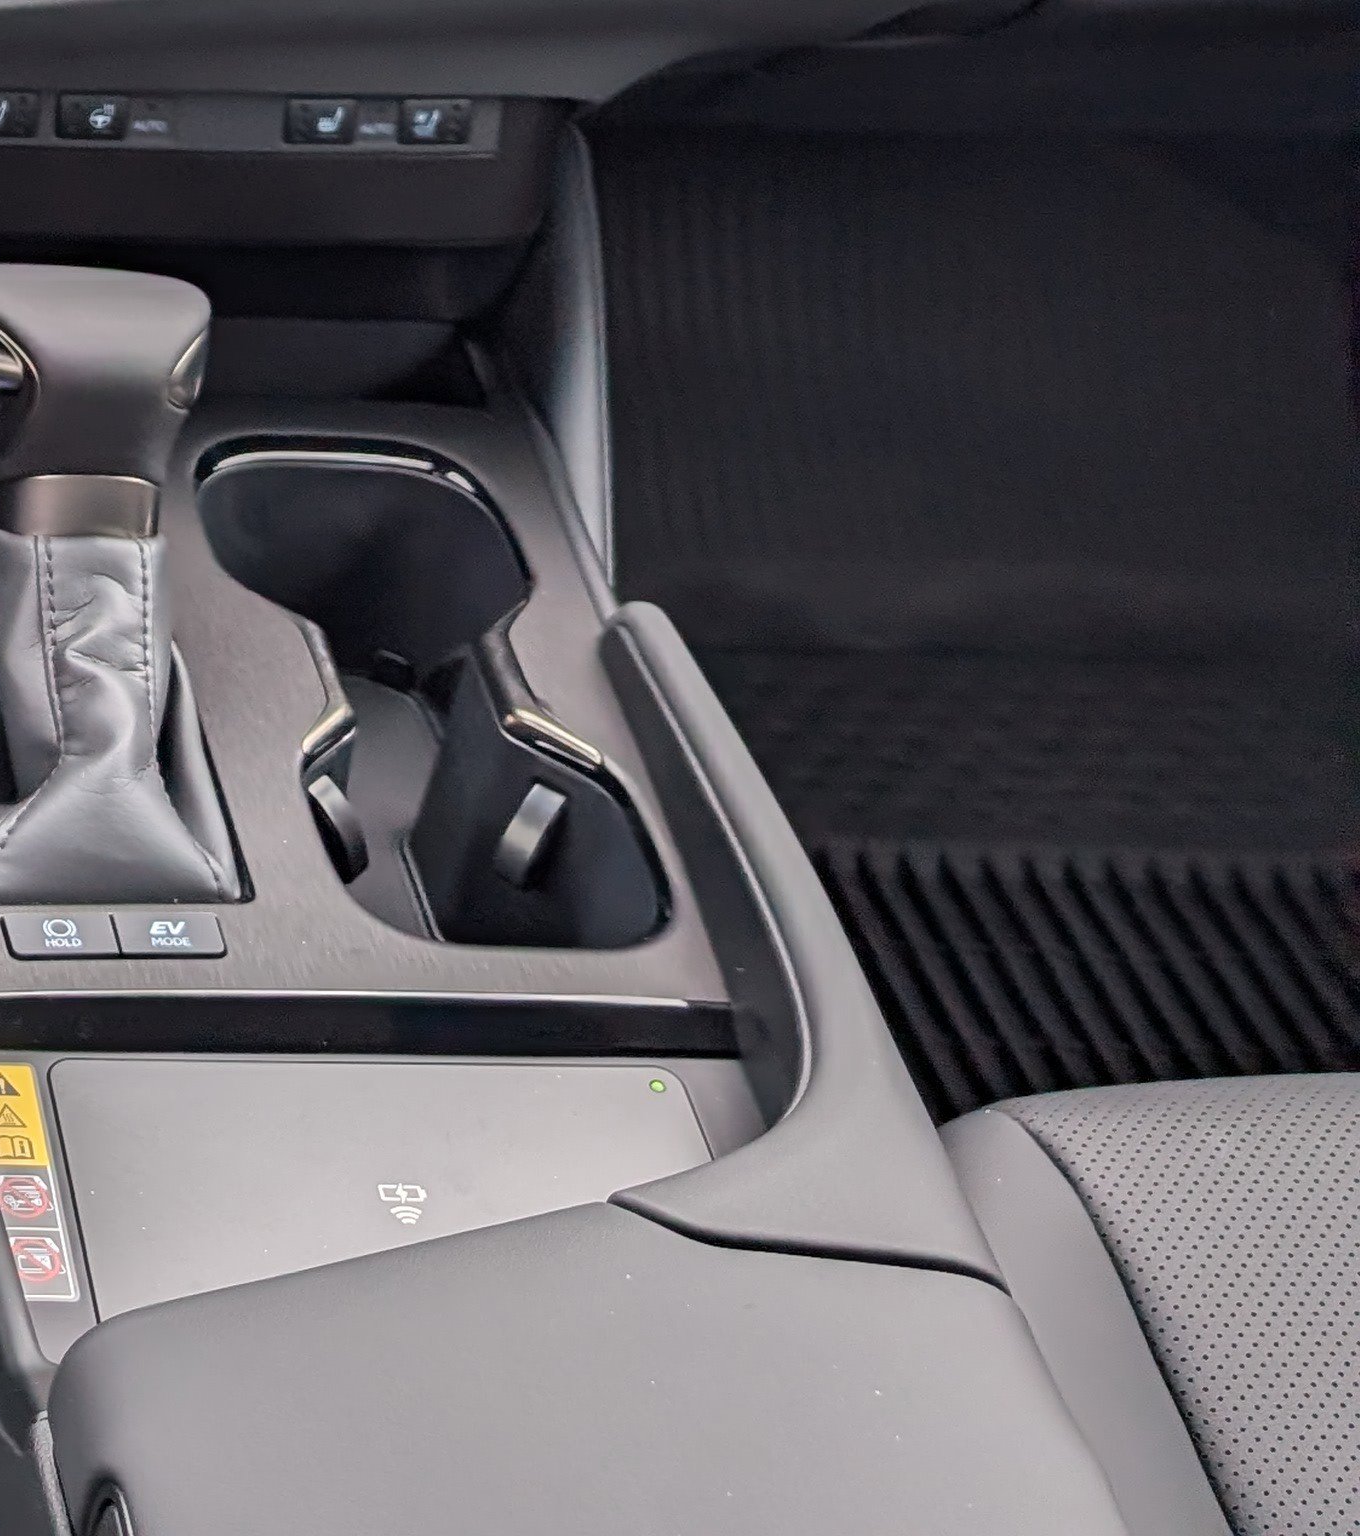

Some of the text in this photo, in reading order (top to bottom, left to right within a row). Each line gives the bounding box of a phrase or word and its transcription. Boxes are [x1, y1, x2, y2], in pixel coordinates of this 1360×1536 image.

[149, 921, 186, 935] EV
[45, 937, 82, 948] HOLD
[151, 937, 191, 947] MODE
